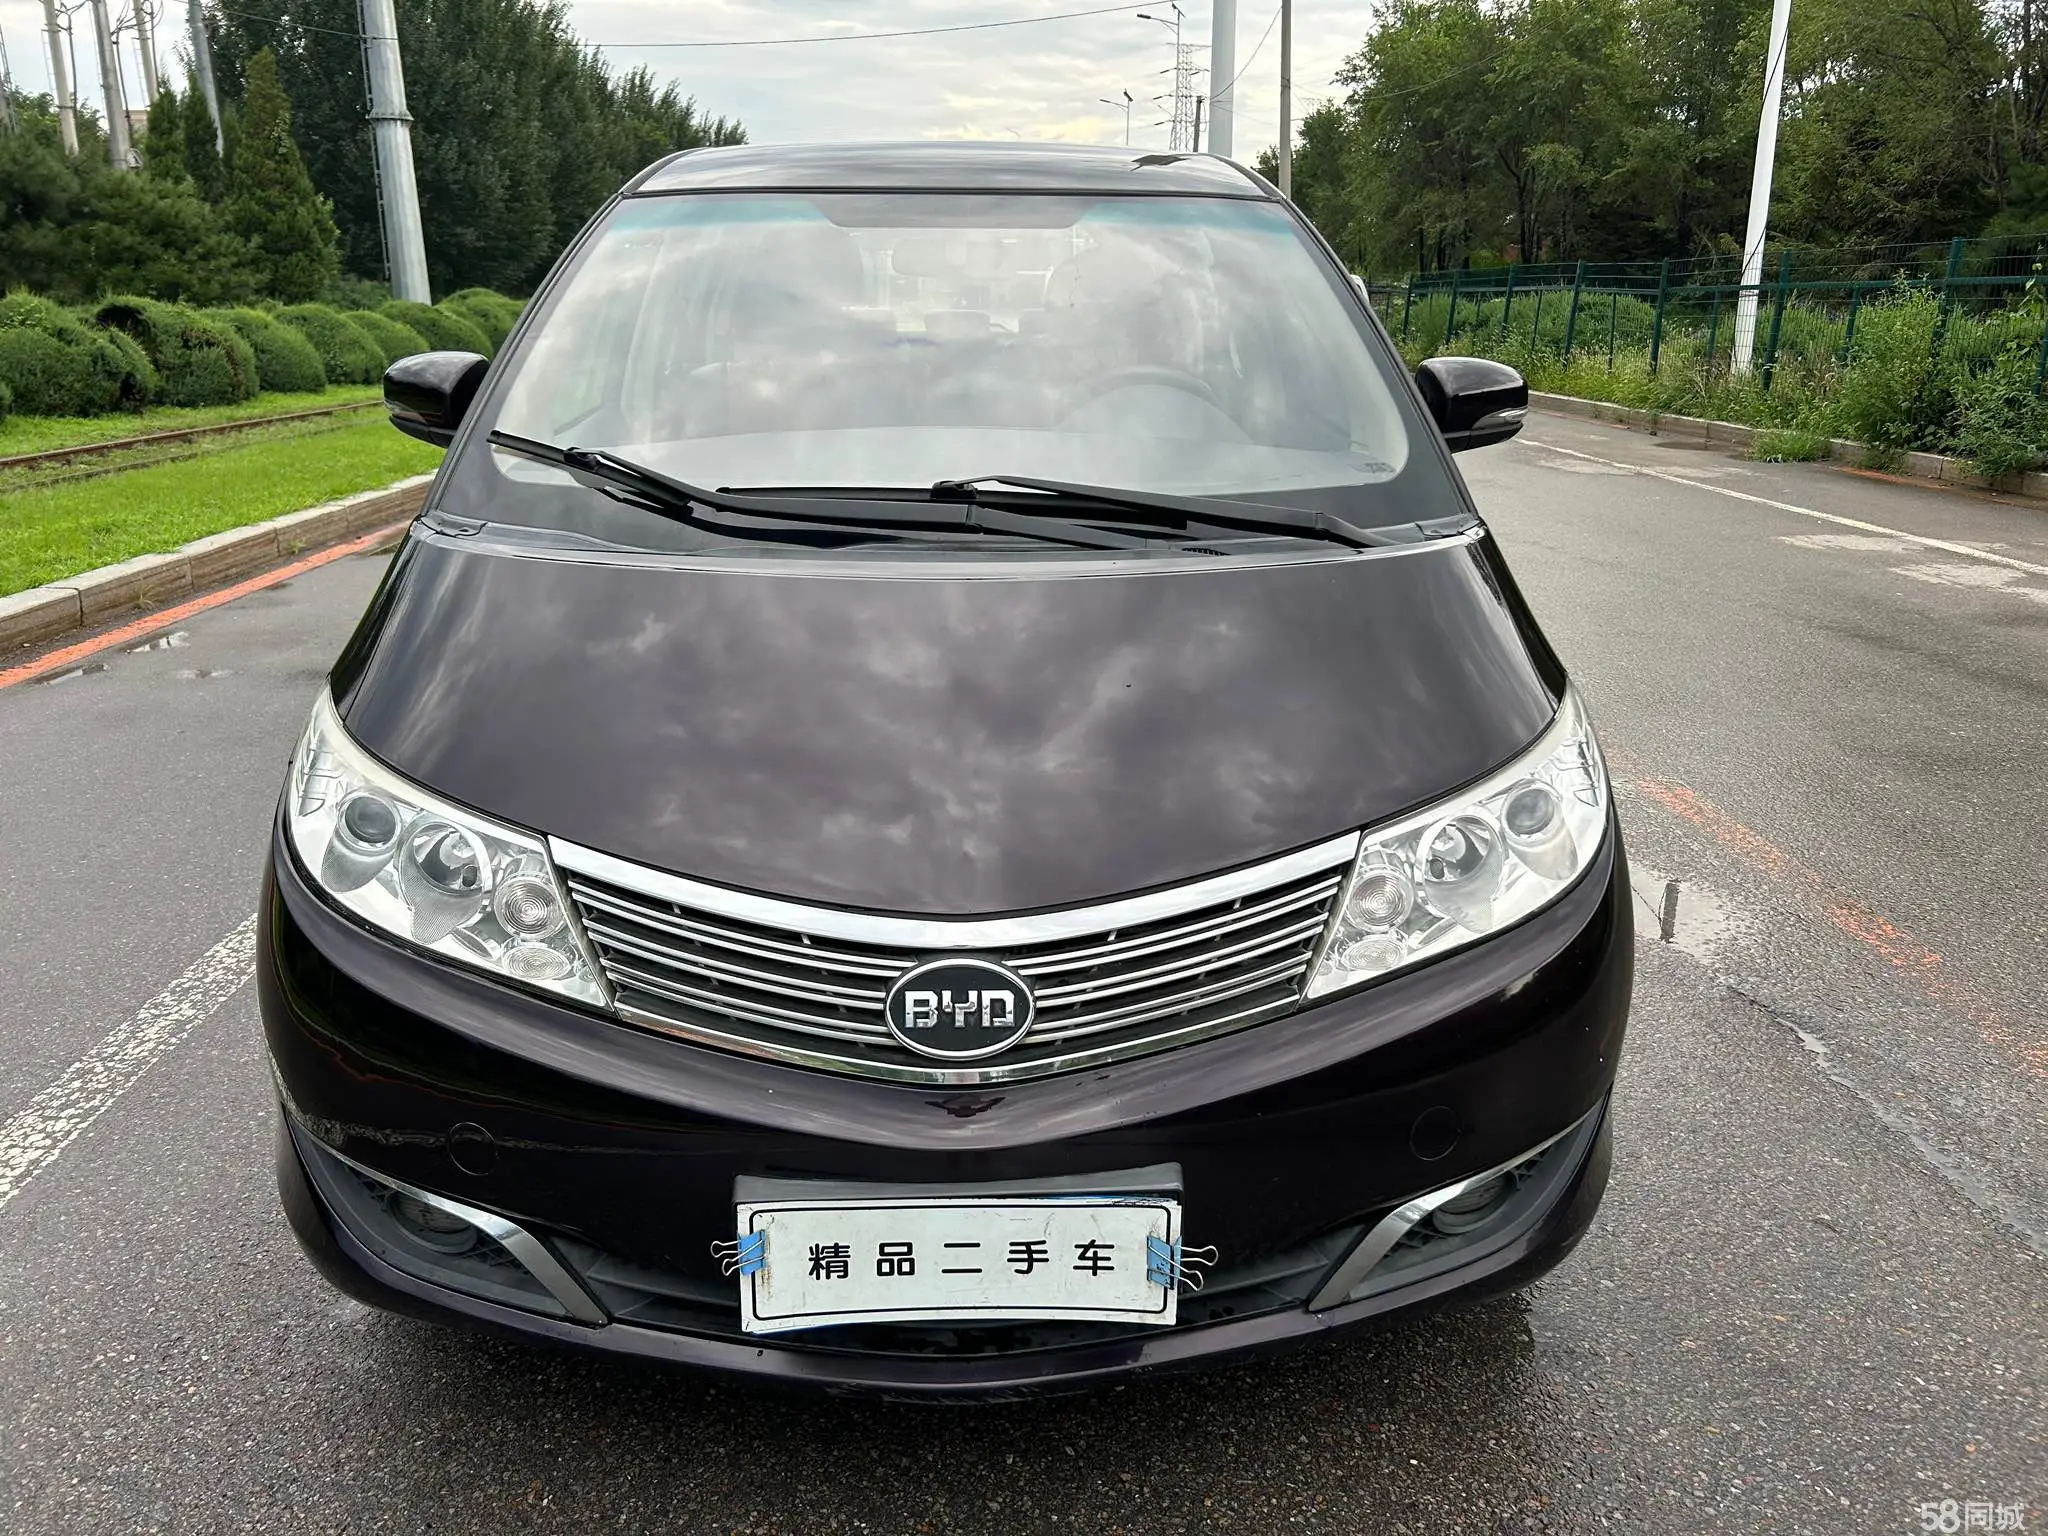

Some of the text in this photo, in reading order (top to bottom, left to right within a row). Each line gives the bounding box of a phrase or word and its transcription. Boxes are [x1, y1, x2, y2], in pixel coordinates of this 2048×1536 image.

[904, 990, 1015, 1028] BYD
[808, 1240, 1115, 1280] 精品二手车
